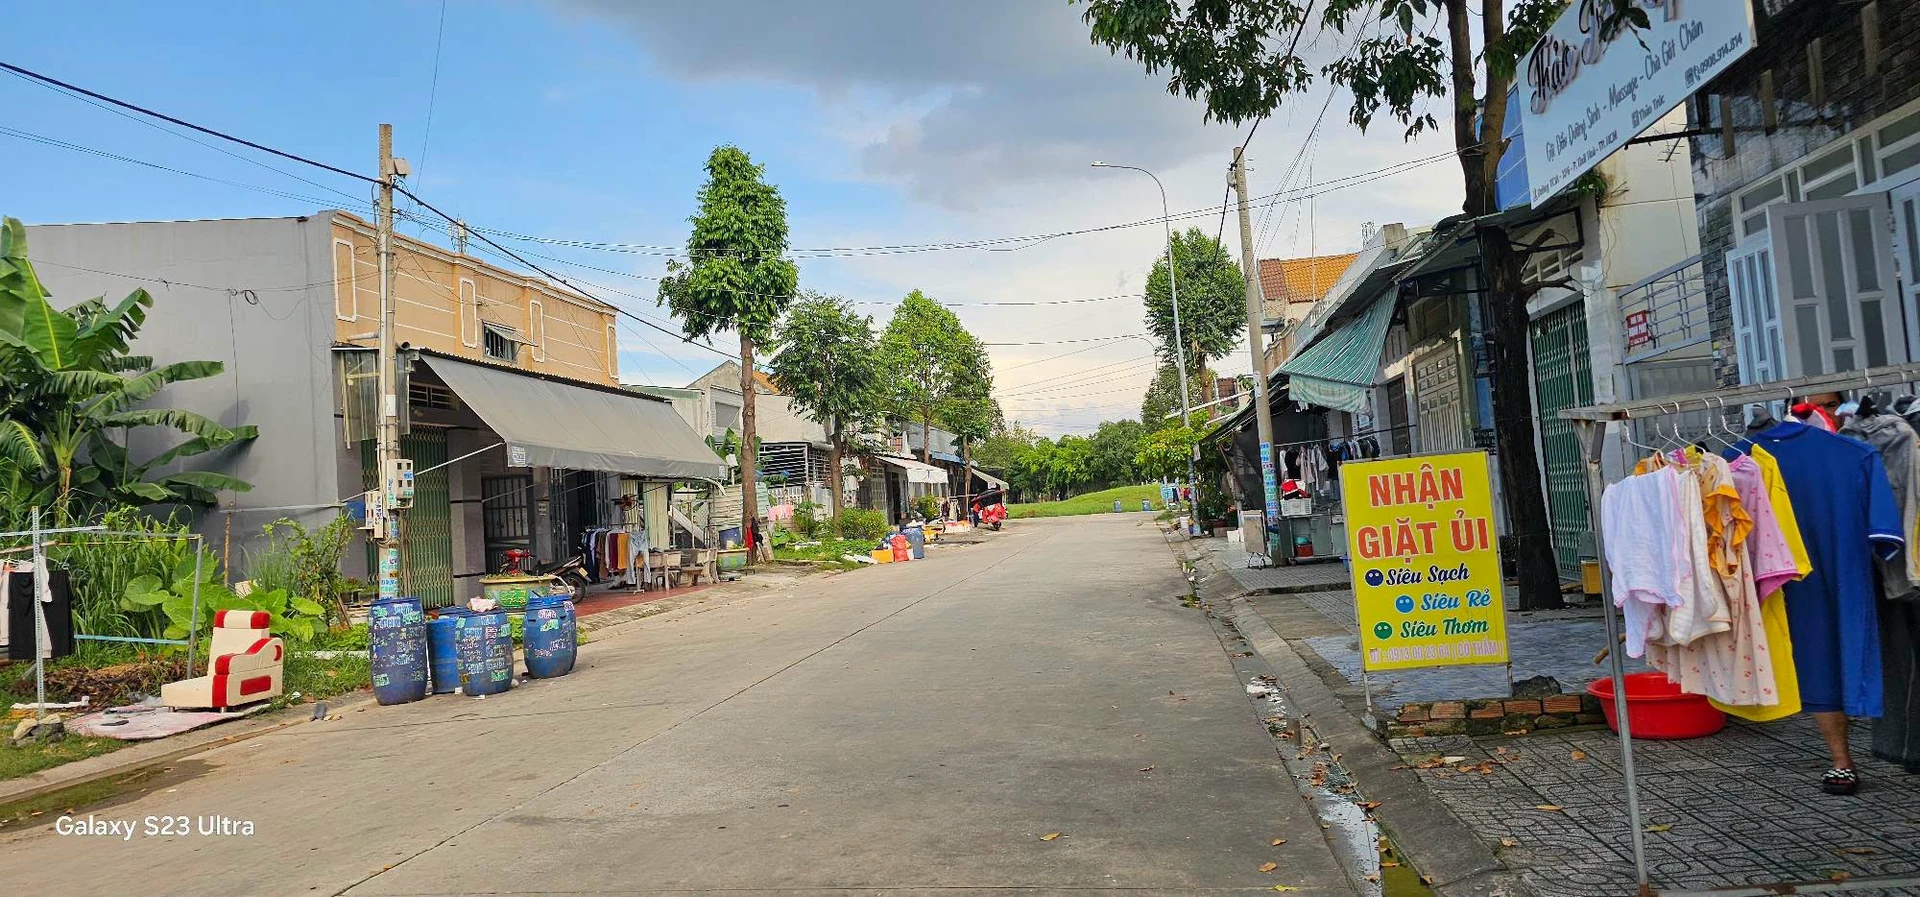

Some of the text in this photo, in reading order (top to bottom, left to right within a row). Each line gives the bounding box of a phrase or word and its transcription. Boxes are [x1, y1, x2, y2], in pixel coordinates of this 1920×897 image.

[1586, 102, 1601, 129] Sinh
[1608, 76, 1639, 112] Massage
[1644, 54, 1662, 80] Chà
[1661, 39, 1676, 67] Gót
[1679, 19, 1704, 51] Chân
[1368, 463, 1464, 510] NHẬN
[1357, 508, 1489, 564] GIẶT ỦI
[1386, 562, 1470, 586] Siêu Sạch
[1421, 588, 1492, 611] Siêu Rẻ
[1400, 617, 1489, 639] Siêu Thơm
